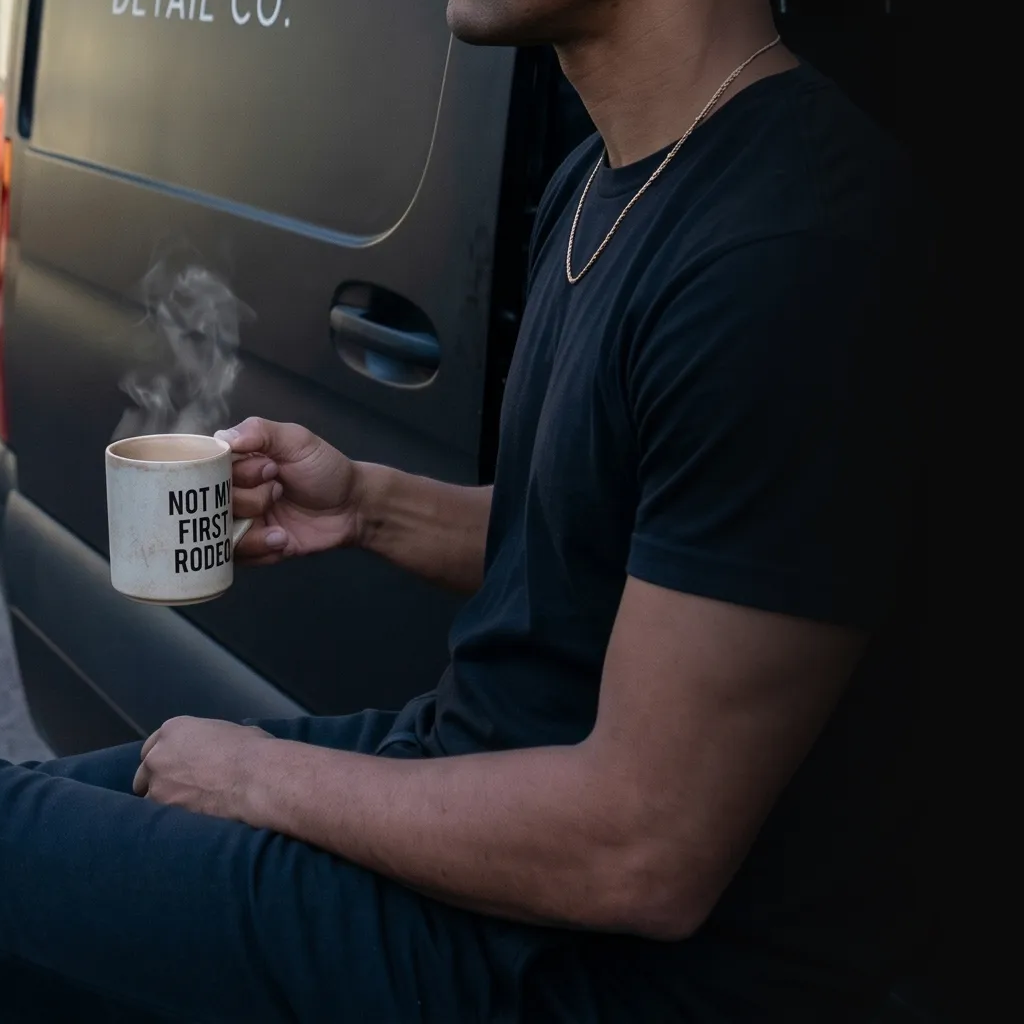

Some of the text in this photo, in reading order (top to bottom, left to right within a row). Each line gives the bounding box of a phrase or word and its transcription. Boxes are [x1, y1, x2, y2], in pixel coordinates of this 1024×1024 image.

[168, 487, 210, 515] NOT
[179, 510, 229, 544] FIRST
[174, 538, 231, 574] RODEO
